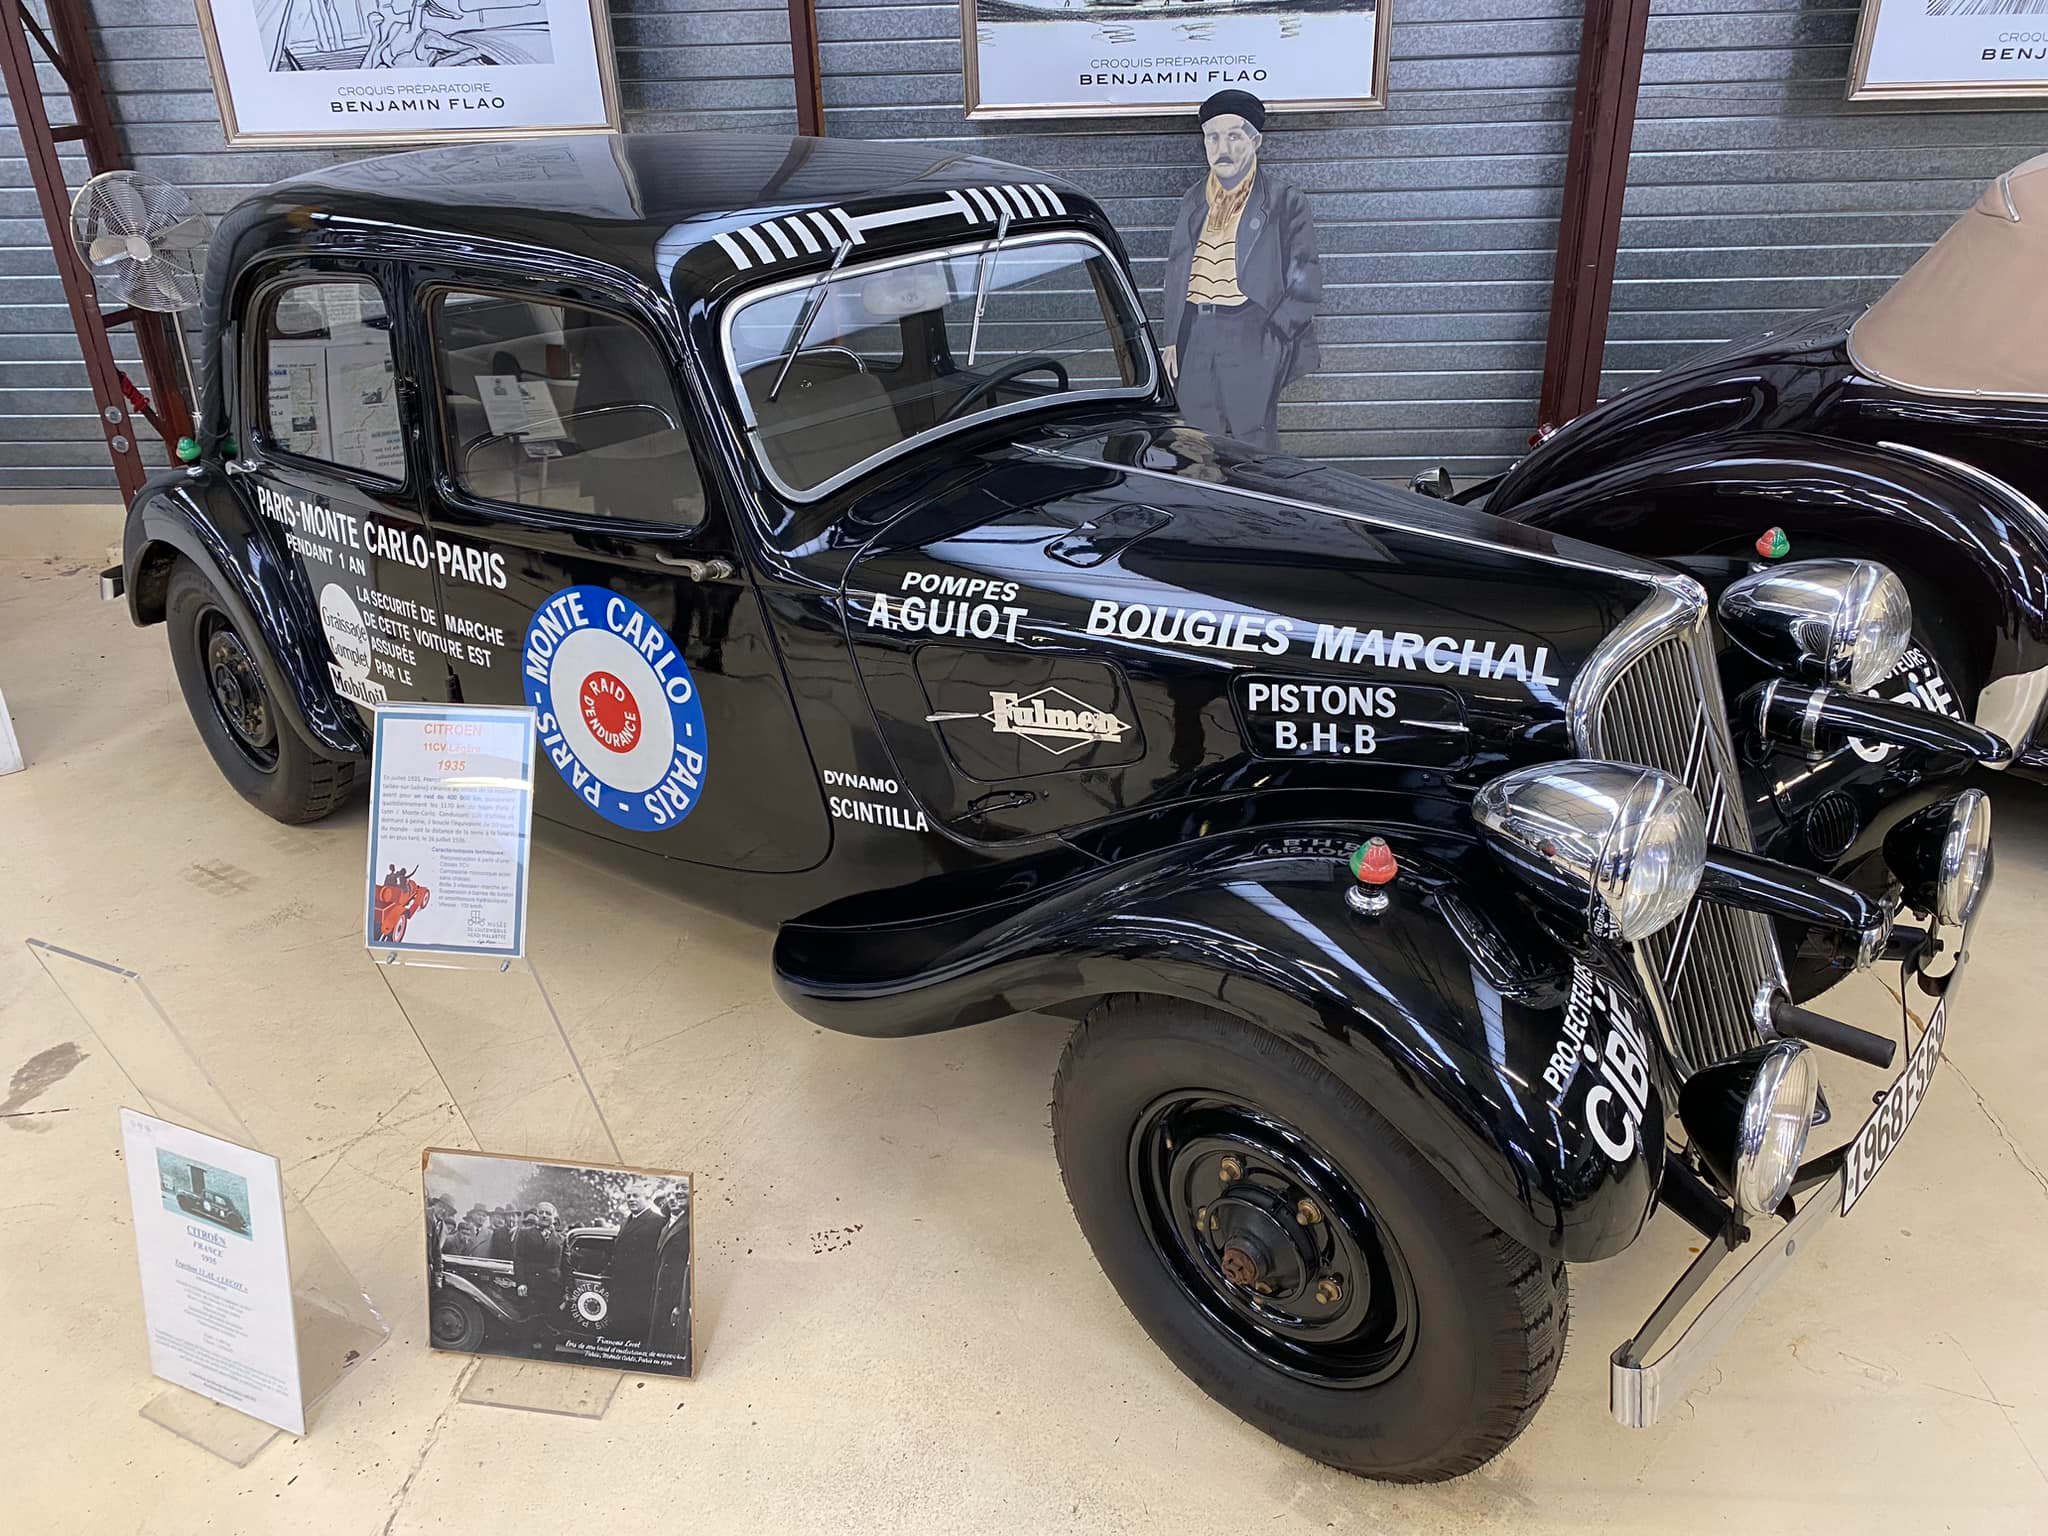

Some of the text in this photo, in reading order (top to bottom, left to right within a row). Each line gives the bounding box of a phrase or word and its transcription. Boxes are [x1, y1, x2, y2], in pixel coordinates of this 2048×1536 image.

[1079, 69, 1268, 86] BENJAMIN FLAO
[1090, 53, 1256, 69] CROQUIS PRÉPARATOIRE
[330, 96, 505, 113] BENJAMIN FLAO
[337, 85, 396, 97] CROQUIS
[256, 485, 507, 591] PARIS-MONTE CARLO-PARIS
[285, 532, 367, 577] PENDANT 1 AN
[901, 571, 1020, 602] POMPES
[322, 606, 368, 644] Graissage
[356, 585, 372, 605] LA
[420, 605, 437, 626] DE
[444, 613, 505, 647] MARCHE
[330, 636, 369, 670] Complet
[363, 610, 492, 669] DE CETTE VOITURE EST
[526, 591, 590, 685] MONTE
[607, 597, 692, 705] CARLO
[1086, 599, 1560, 687] BOUGIES MARCHAL
[332, 667, 386, 706] Mobiloil
[374, 658, 414, 687] PAR LE
[588, 677, 626, 702] RAID
[989, 691, 1118, 736] Fulmen
[1248, 683, 1397, 719] PISTONS
[423, 743, 447, 752] 11CV
[1275, 721, 1377, 755] B.H.B
[437, 760, 466, 771] 1935
[537, 710, 602, 808] PARIS
[643, 743, 704, 825] PARIS
[823, 769, 898, 794] DYNAMO
[829, 796, 929, 833] SCINTILLA
[1543, 956, 1593, 1093] PROJECTEURS
